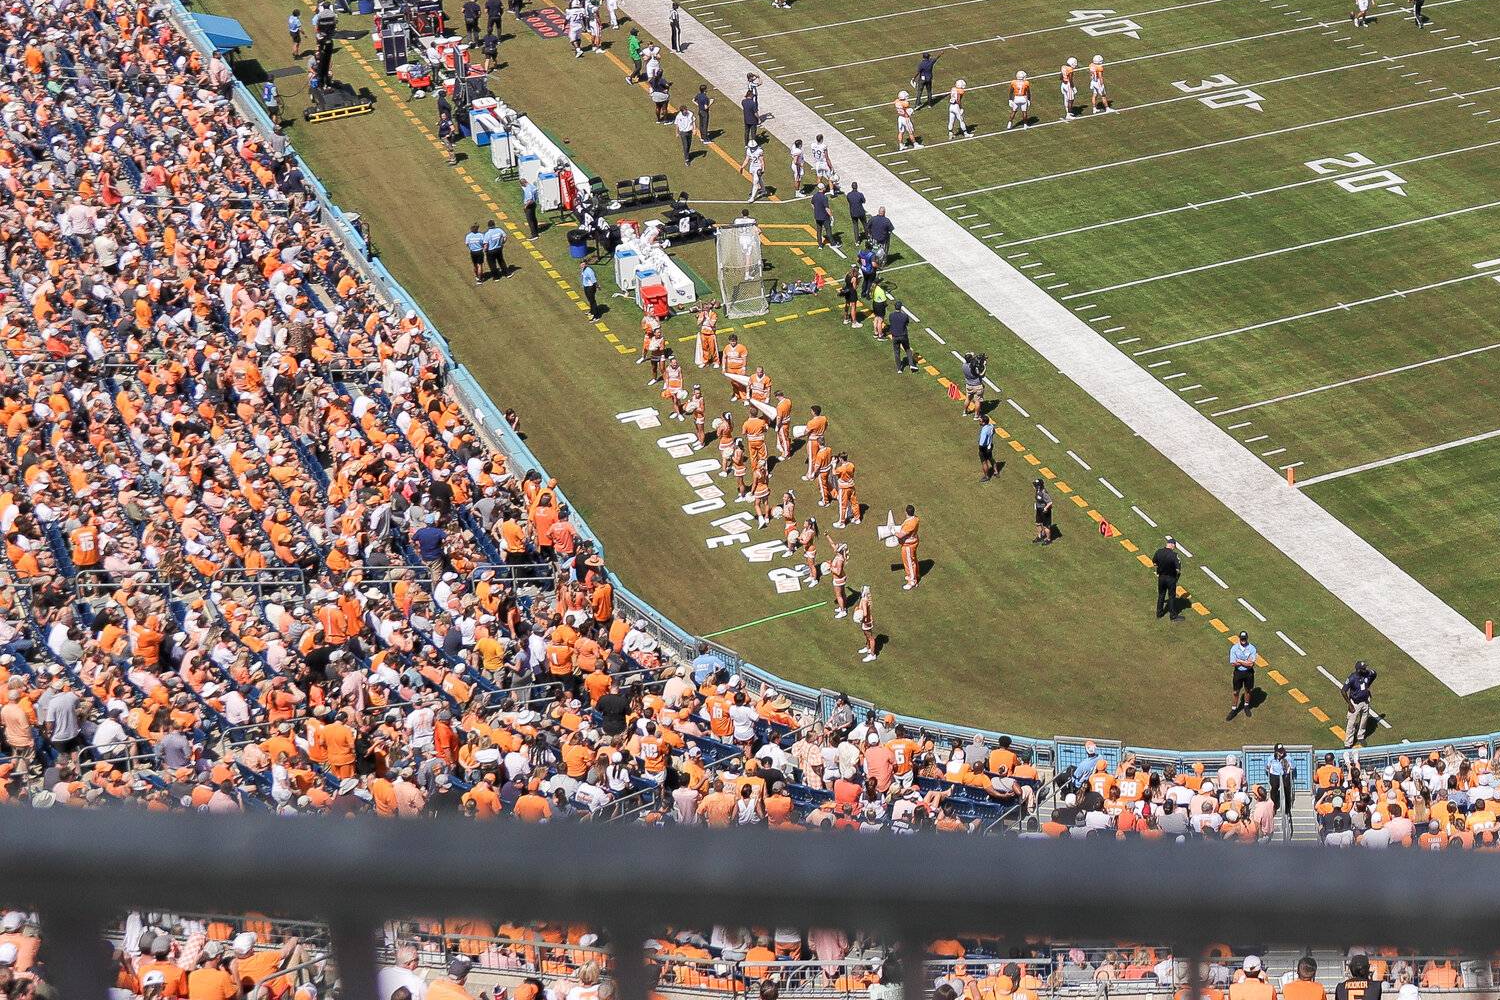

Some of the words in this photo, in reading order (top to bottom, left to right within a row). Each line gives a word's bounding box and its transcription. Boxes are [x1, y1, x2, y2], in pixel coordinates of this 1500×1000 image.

[1066, 8, 1140, 37] 40
[1017, 85, 1023, 95] 7
[1172, 73, 1266, 111] 30
[1304, 152, 1407, 195] 20
[895, 749, 905, 764] 6
[1119, 781, 1137, 797] 98
[1345, 981, 1368, 989] HOOKER
